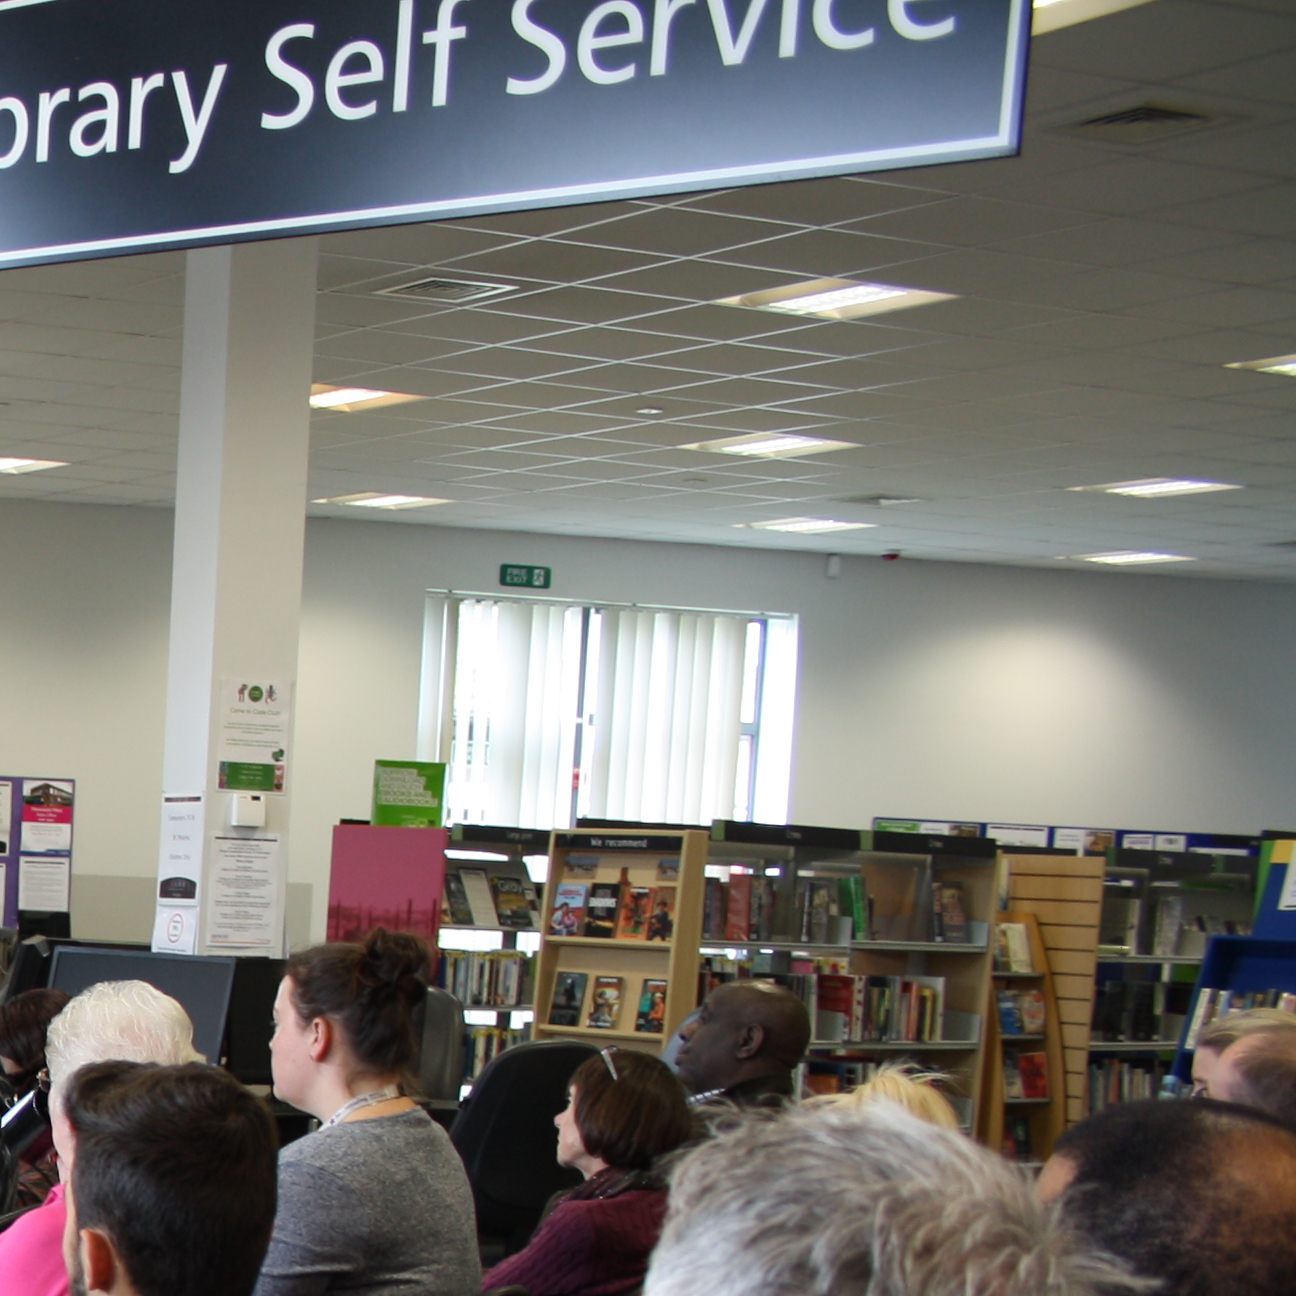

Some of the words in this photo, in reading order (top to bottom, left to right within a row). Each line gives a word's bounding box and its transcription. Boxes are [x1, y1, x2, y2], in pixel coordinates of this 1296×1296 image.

[261, 0, 468, 130] Self
[590, 837, 603, 848] We
[605, 838, 648, 849] recommend
